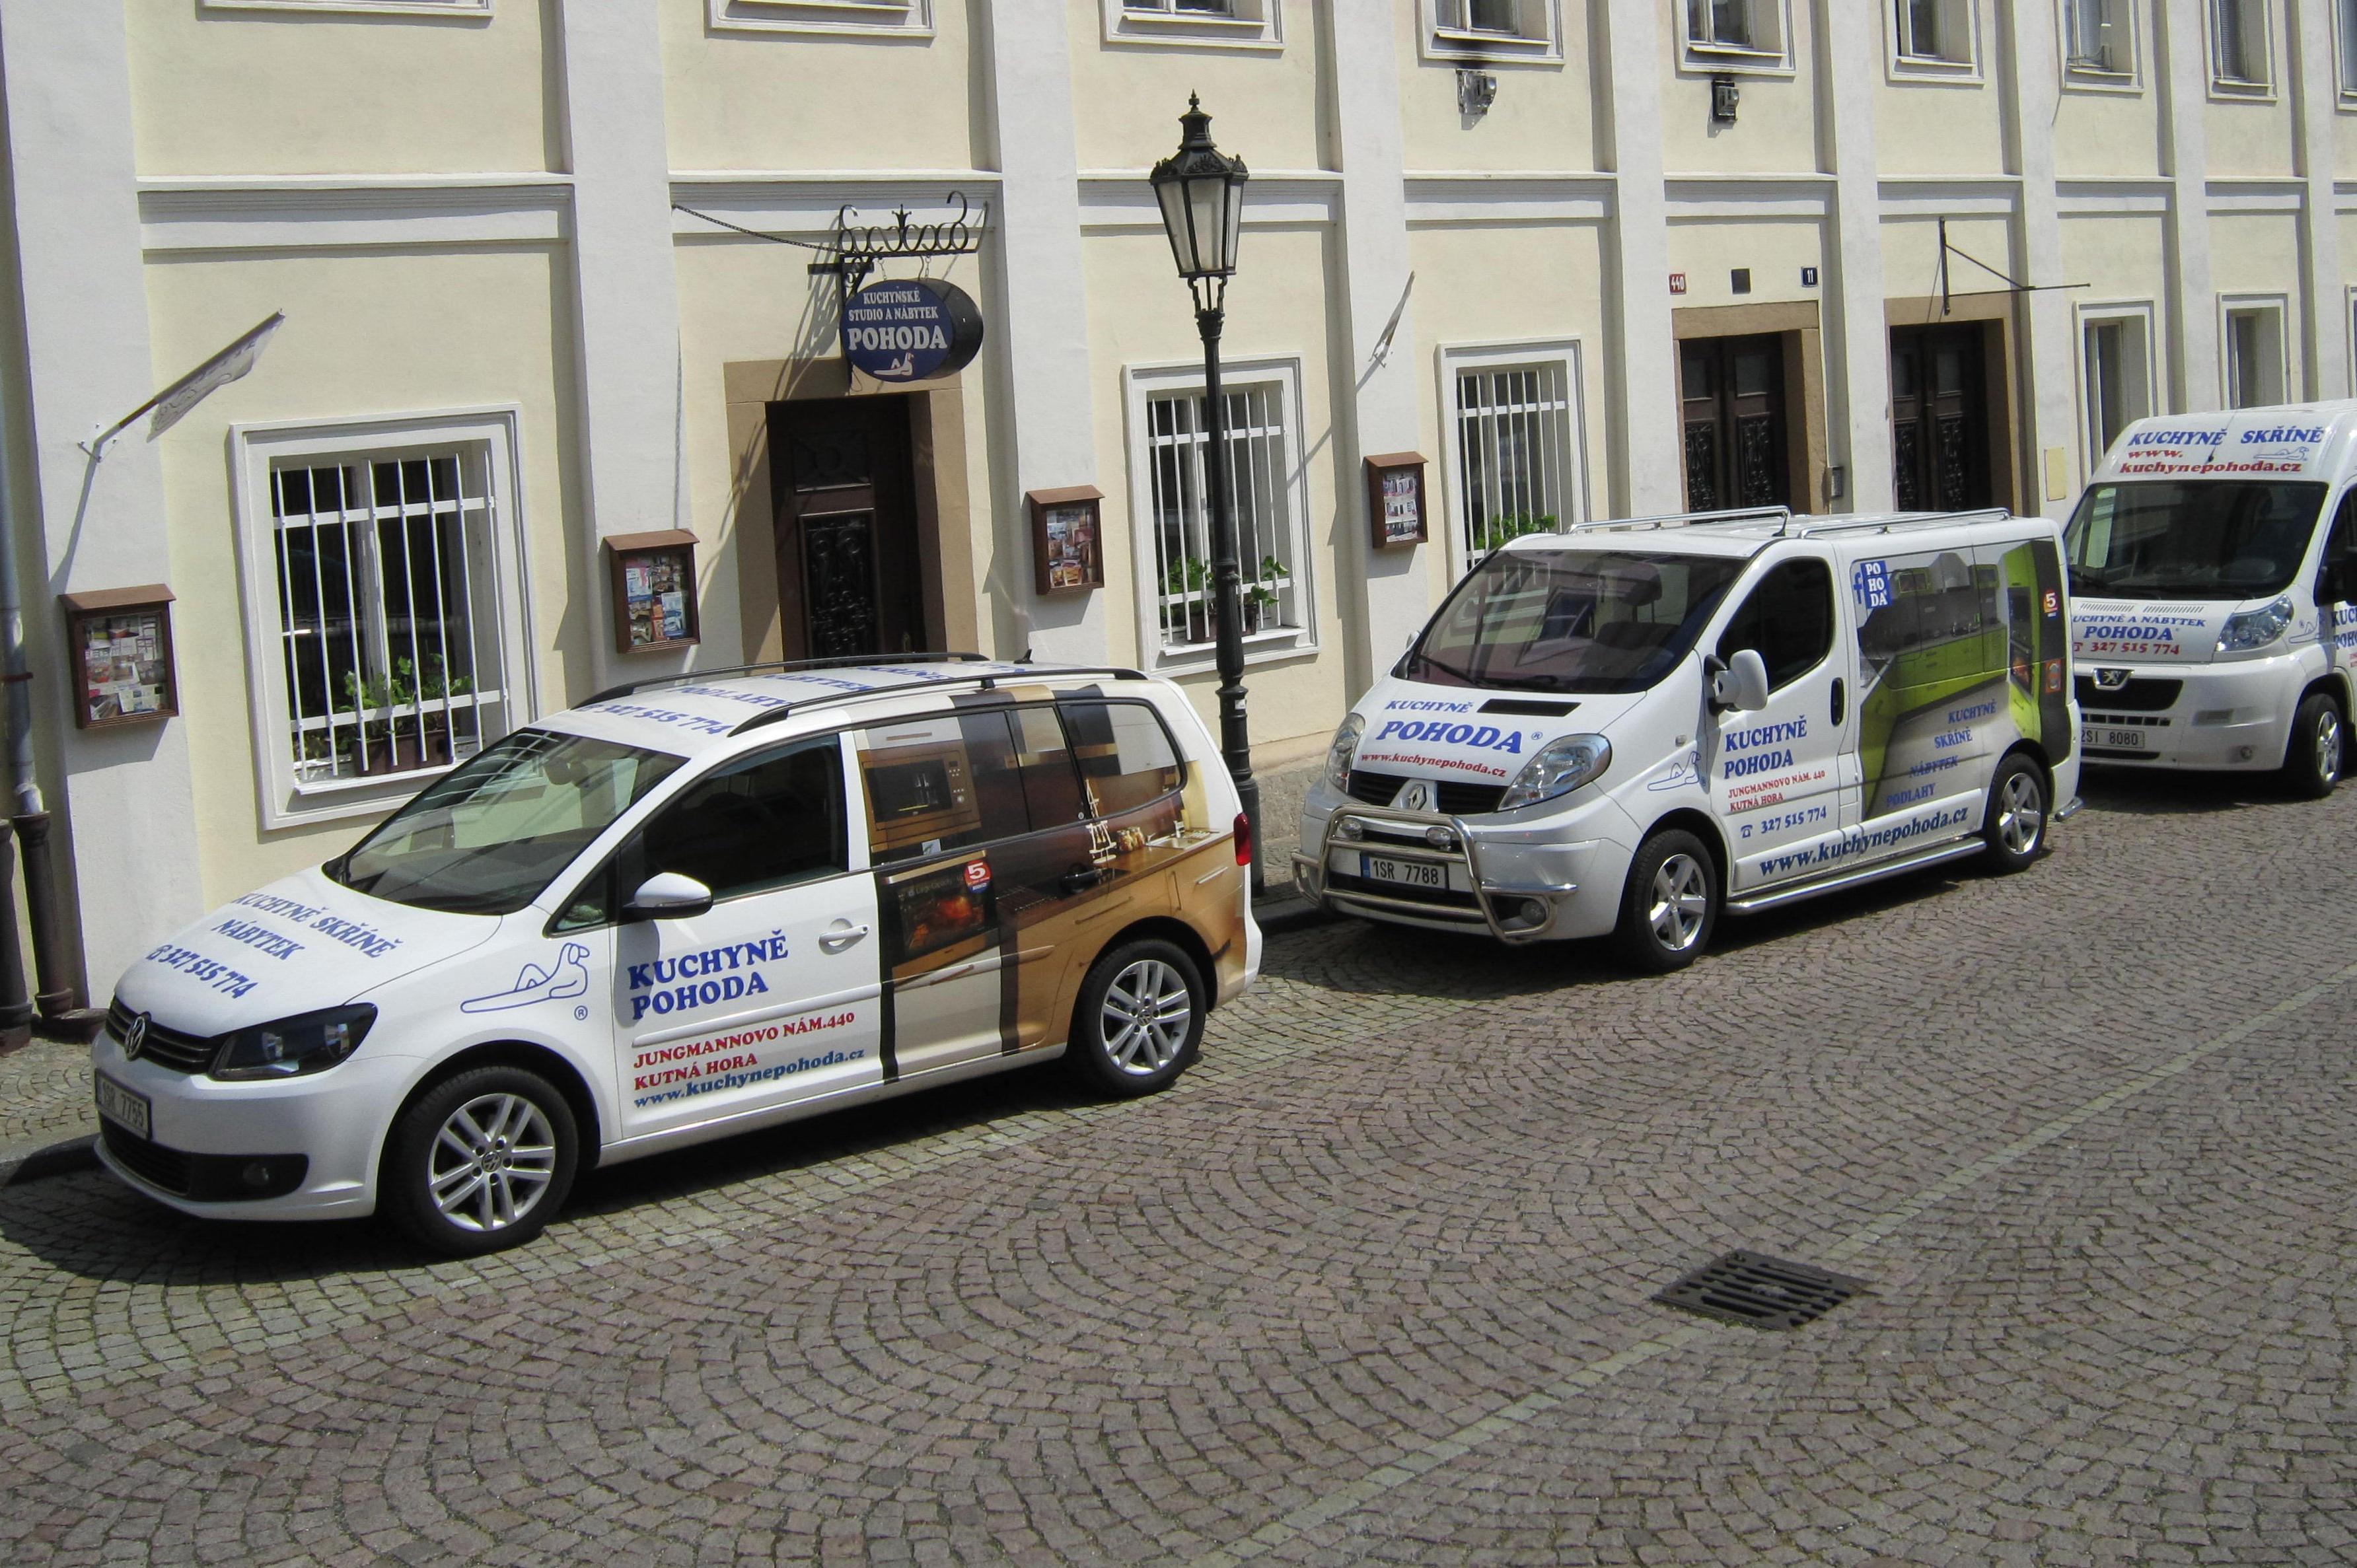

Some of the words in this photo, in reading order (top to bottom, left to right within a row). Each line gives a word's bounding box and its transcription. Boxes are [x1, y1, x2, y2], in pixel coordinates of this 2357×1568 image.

[1671, 276, 1684, 291] 440
[1807, 269, 1813, 283] 11
[848, 308, 883, 322] STUDIO
[885, 308, 892, 320] A
[894, 304, 939, 321] NÁBYTEK
[847, 325, 948, 350] POHODA
[2127, 428, 2227, 446] KUCHYNĚ
[2240, 425, 2325, 444] SKŘÍNĚ
[2119, 460, 2303, 474] kuchynepohoda.cz
[1865, 562, 1881, 575] PO
[1867, 577, 1885, 592] HO
[2045, 592, 2056, 608] 5
[2072, 614, 2124, 623] UCHYNĚ
[2140, 615, 2206, 627] NÁBYTEK
[2084, 626, 2173, 641] POHODA
[2090, 642, 2116, 653] 327
[2121, 643, 2148, 653] 515
[2153, 644, 2181, 655] 774
[1385, 700, 1473, 713] KUCHYNĚ
[1949, 699, 1997, 724] KUCHYNĚ
[633, 709, 688, 722] 515
[678, 717, 735, 734] 774
[1725, 715, 1807, 752] KUCHYNĚ
[1375, 721, 1522, 754] POHODA
[1934, 727, 1973, 749] SKŘÍNĚ
[2109, 731, 2138, 745] 8080
[1361, 753, 1507, 777] www.kuchynepohoda.cz
[1724, 749, 1794, 779] POHODA
[1728, 777, 1790, 799] JUNGMANNOVO
[1813, 770, 1825, 779] 440
[1887, 783, 1936, 806] PODLAHY
[1730, 795, 1759, 812] KUTNÁ
[1760, 793, 1784, 804] HORA
[1761, 817, 1781, 834] 327
[1785, 811, 1804, 828] 515
[1807, 805, 1827, 822] 774
[1759, 807, 1969, 876] www.kuchynepohoda.cz
[968, 862, 986, 879] 5
[1373, 860, 1395, 880] 1SR
[1404, 865, 1438, 884] 7788
[231, 893, 328, 922] KUCHYNĚ
[309, 917, 404, 958] SKŘÍNĚ
[211, 919, 305, 960] NÁBYTEK
[627, 929, 789, 990] KUCHYNĚ
[158, 948, 195, 969] 327
[184, 958, 228, 981] 515
[212, 971, 258, 999] 774
[631, 972, 768, 1020] POHODA
[634, 1026, 779, 1069] JUNGMANNOVO
[634, 1061, 700, 1090] KUTNÁ
[706, 1053, 758, 1075] HORA
[634, 1049, 865, 1109] www.kuchynepohoda.cz
